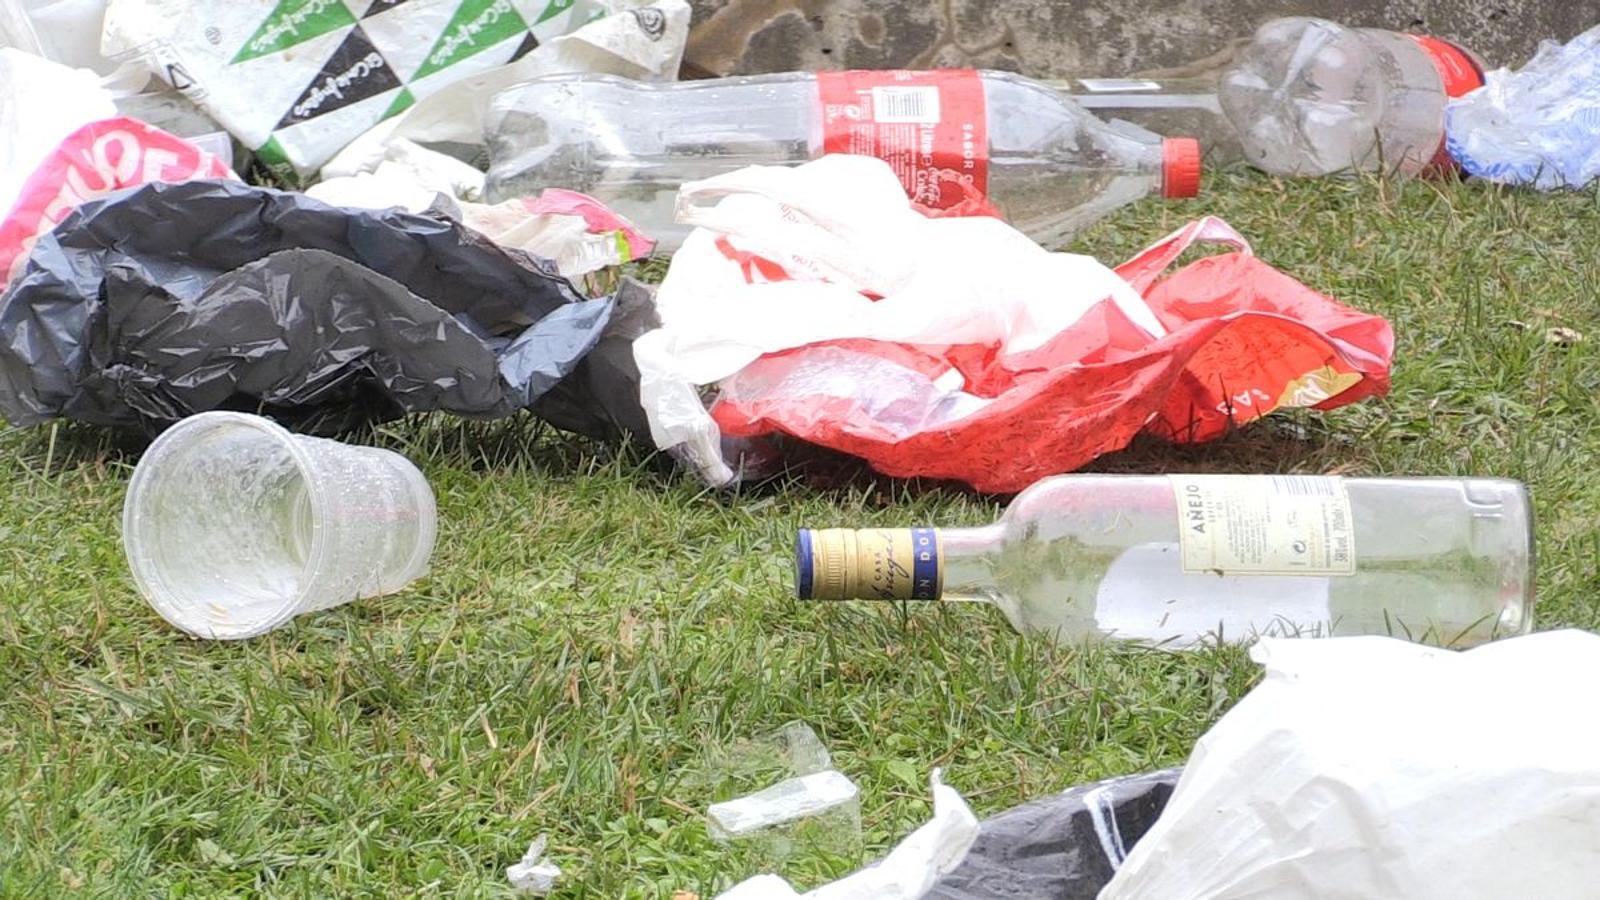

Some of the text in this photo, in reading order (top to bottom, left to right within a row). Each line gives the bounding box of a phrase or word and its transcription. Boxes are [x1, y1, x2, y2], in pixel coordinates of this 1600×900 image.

[962, 123, 974, 170] SABOR
[1186, 484, 1206, 534] AÑEJO
[874, 552, 882, 581] CASA
